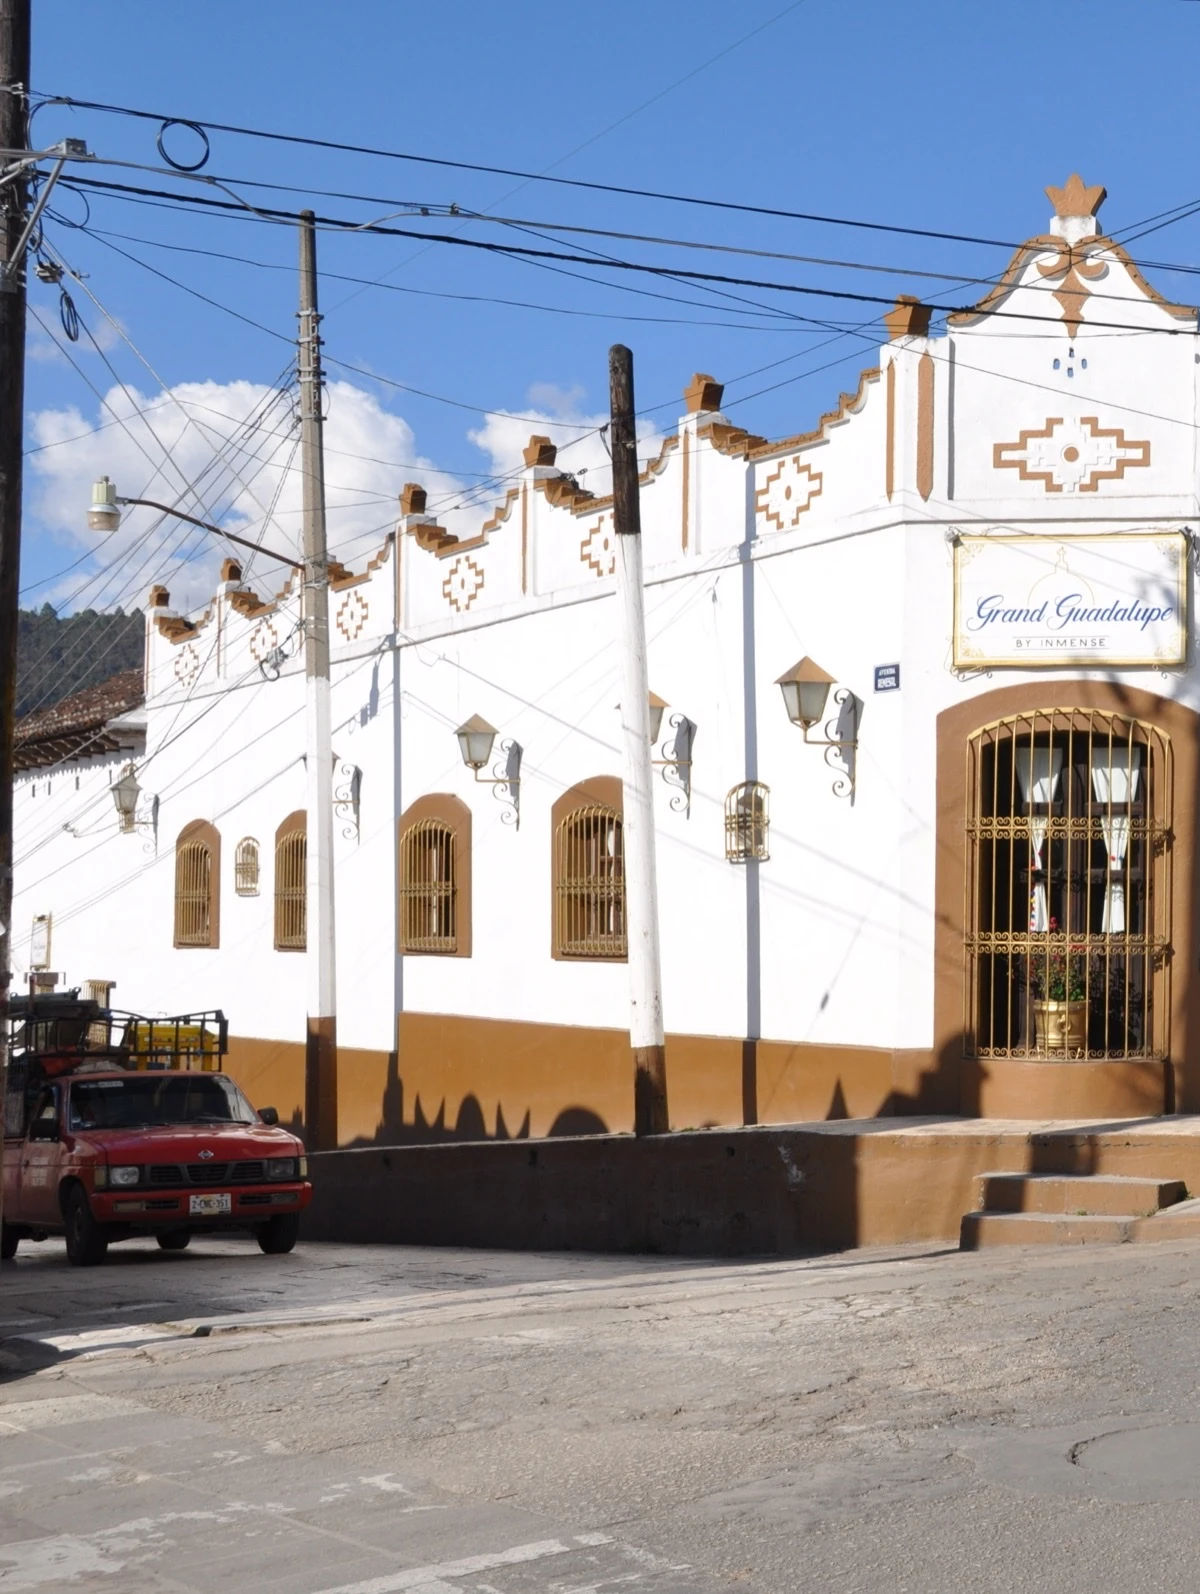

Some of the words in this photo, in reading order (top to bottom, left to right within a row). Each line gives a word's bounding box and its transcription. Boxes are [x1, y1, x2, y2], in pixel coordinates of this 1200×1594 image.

[966, 594, 1049, 631] Grand
[1047, 593, 1174, 631] Guadalupe
[1015, 639, 1032, 648] BY
[1040, 638, 1106, 648] INMENSE
